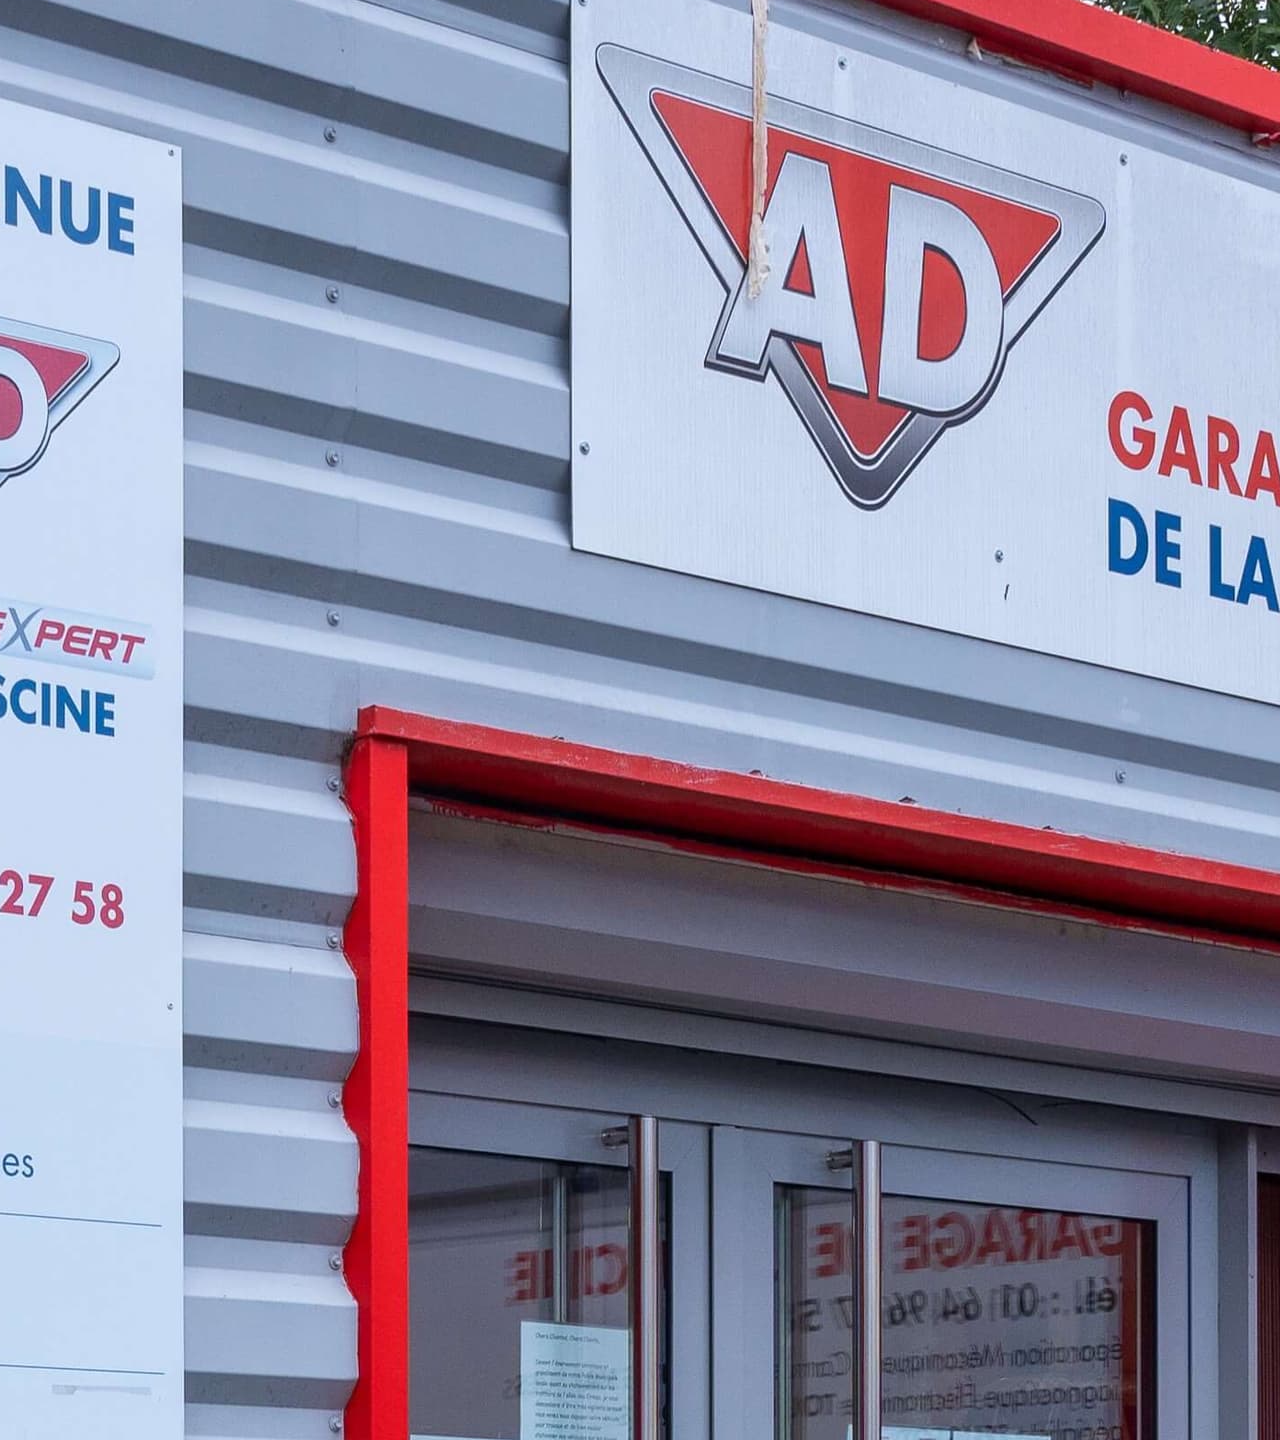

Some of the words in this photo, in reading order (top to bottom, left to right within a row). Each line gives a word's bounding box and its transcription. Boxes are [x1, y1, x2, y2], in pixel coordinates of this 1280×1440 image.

[712, 148, 1005, 414] AD
[1108, 498, 1181, 588] DE
[1210, 524, 1280, 613] LA
[0, 870, 54, 917] 27
[72, 881, 124, 928] 58
